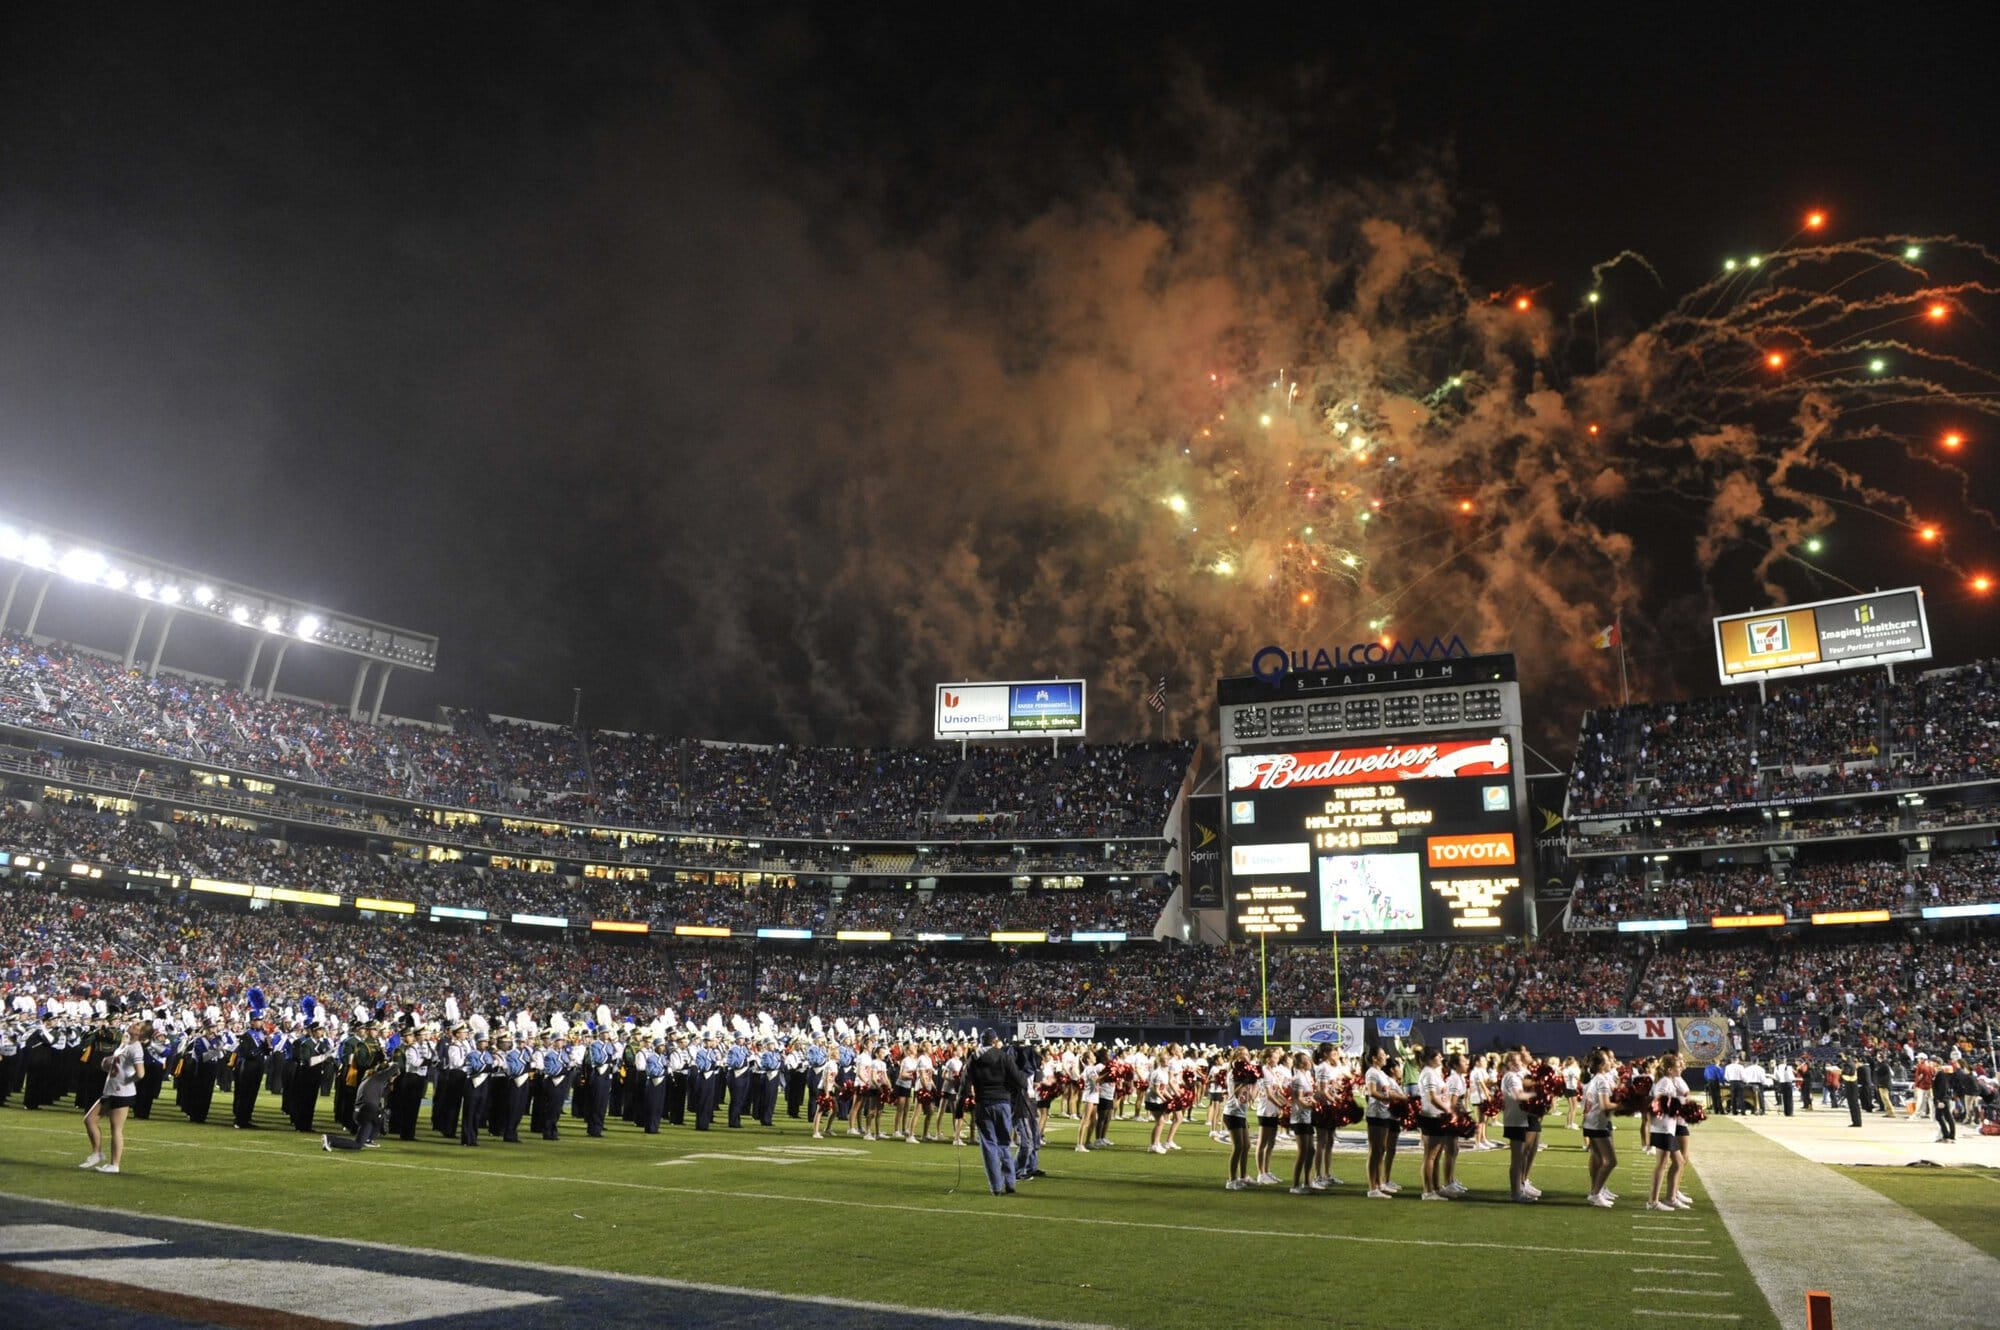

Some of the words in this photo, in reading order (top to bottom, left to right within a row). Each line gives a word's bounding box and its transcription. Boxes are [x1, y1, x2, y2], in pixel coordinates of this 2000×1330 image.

[1756, 625, 1777, 651] 7
[1821, 628, 1861, 640] Imaging
[1862, 620, 1918, 634] Healthcare
[1829, 646, 1845, 654] Your
[1847, 642, 1874, 652] Partner
[1886, 637, 1911, 646] Health
[1298, 666, 1453, 689] STADIUM
[944, 713, 1005, 724] UnionBank
[1013, 719, 1036, 727] ready.
[1051, 718, 1077, 726] thrive.
[1254, 746, 1438, 789] Budweiser
[1379, 785, 1395, 797] TO
[1325, 801, 1346, 814] DR
[1350, 797, 1406, 813] PEPPER
[1305, 813, 1383, 829] HALFTIME
[1391, 810, 1433, 825] SHOW
[1191, 850, 1219, 864] Sprint
[1432, 842, 1511, 860] TOYOTA
[1644, 1020, 1666, 1038] N
[1446, 1038, 1466, 1054] 25
